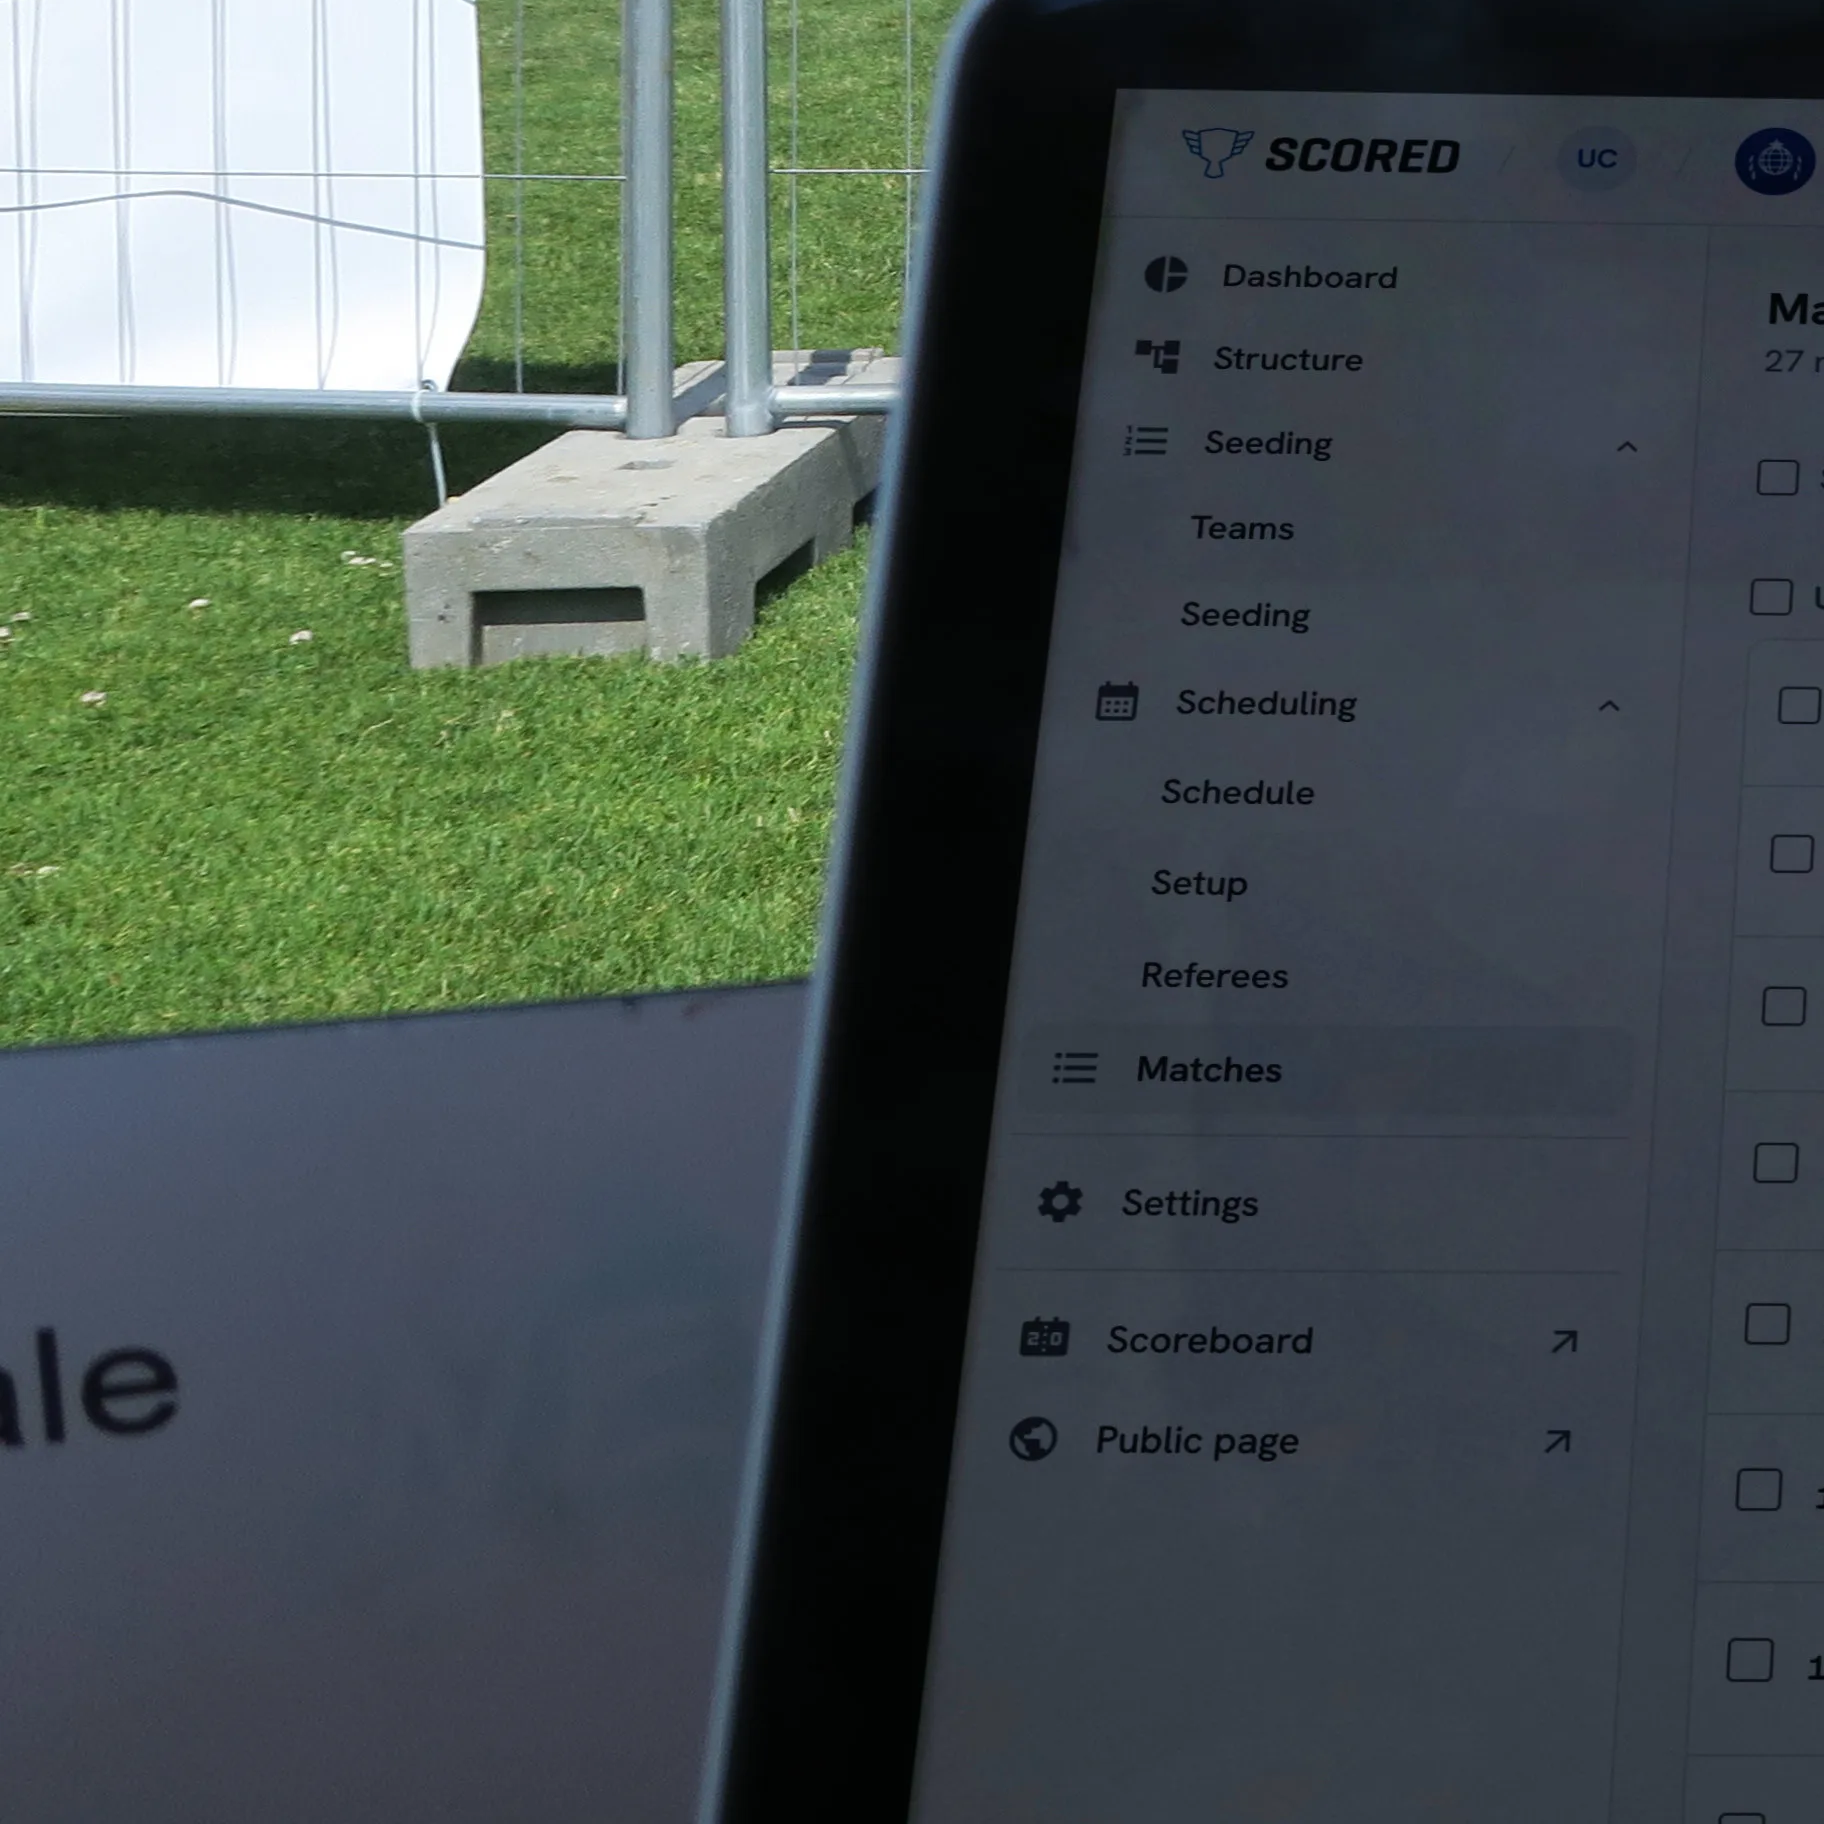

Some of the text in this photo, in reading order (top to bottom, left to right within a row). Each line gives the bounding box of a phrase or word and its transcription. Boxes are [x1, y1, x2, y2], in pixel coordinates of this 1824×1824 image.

[1265, 136, 1461, 174] SCORED
[1577, 148, 1618, 169] UC
[1223, 263, 1398, 289] Dashboard
[1213, 345, 1364, 372] Structure
[1764, 348, 1805, 373] 27
[1204, 429, 1334, 462] Seeding
[1190, 514, 1295, 541] Teams
[1180, 600, 1311, 635] Seeding
[1176, 689, 1358, 723] Scheduling
[1161, 778, 1315, 806] Schedule
[1151, 868, 1248, 903] Setup
[1141, 961, 1289, 989] Referees
[1137, 1055, 1282, 1083] Matches
[1121, 1188, 1259, 1225] Settings
[1106, 1325, 1314, 1355] Scoreboard
[1096, 1425, 1300, 1463] Public page
